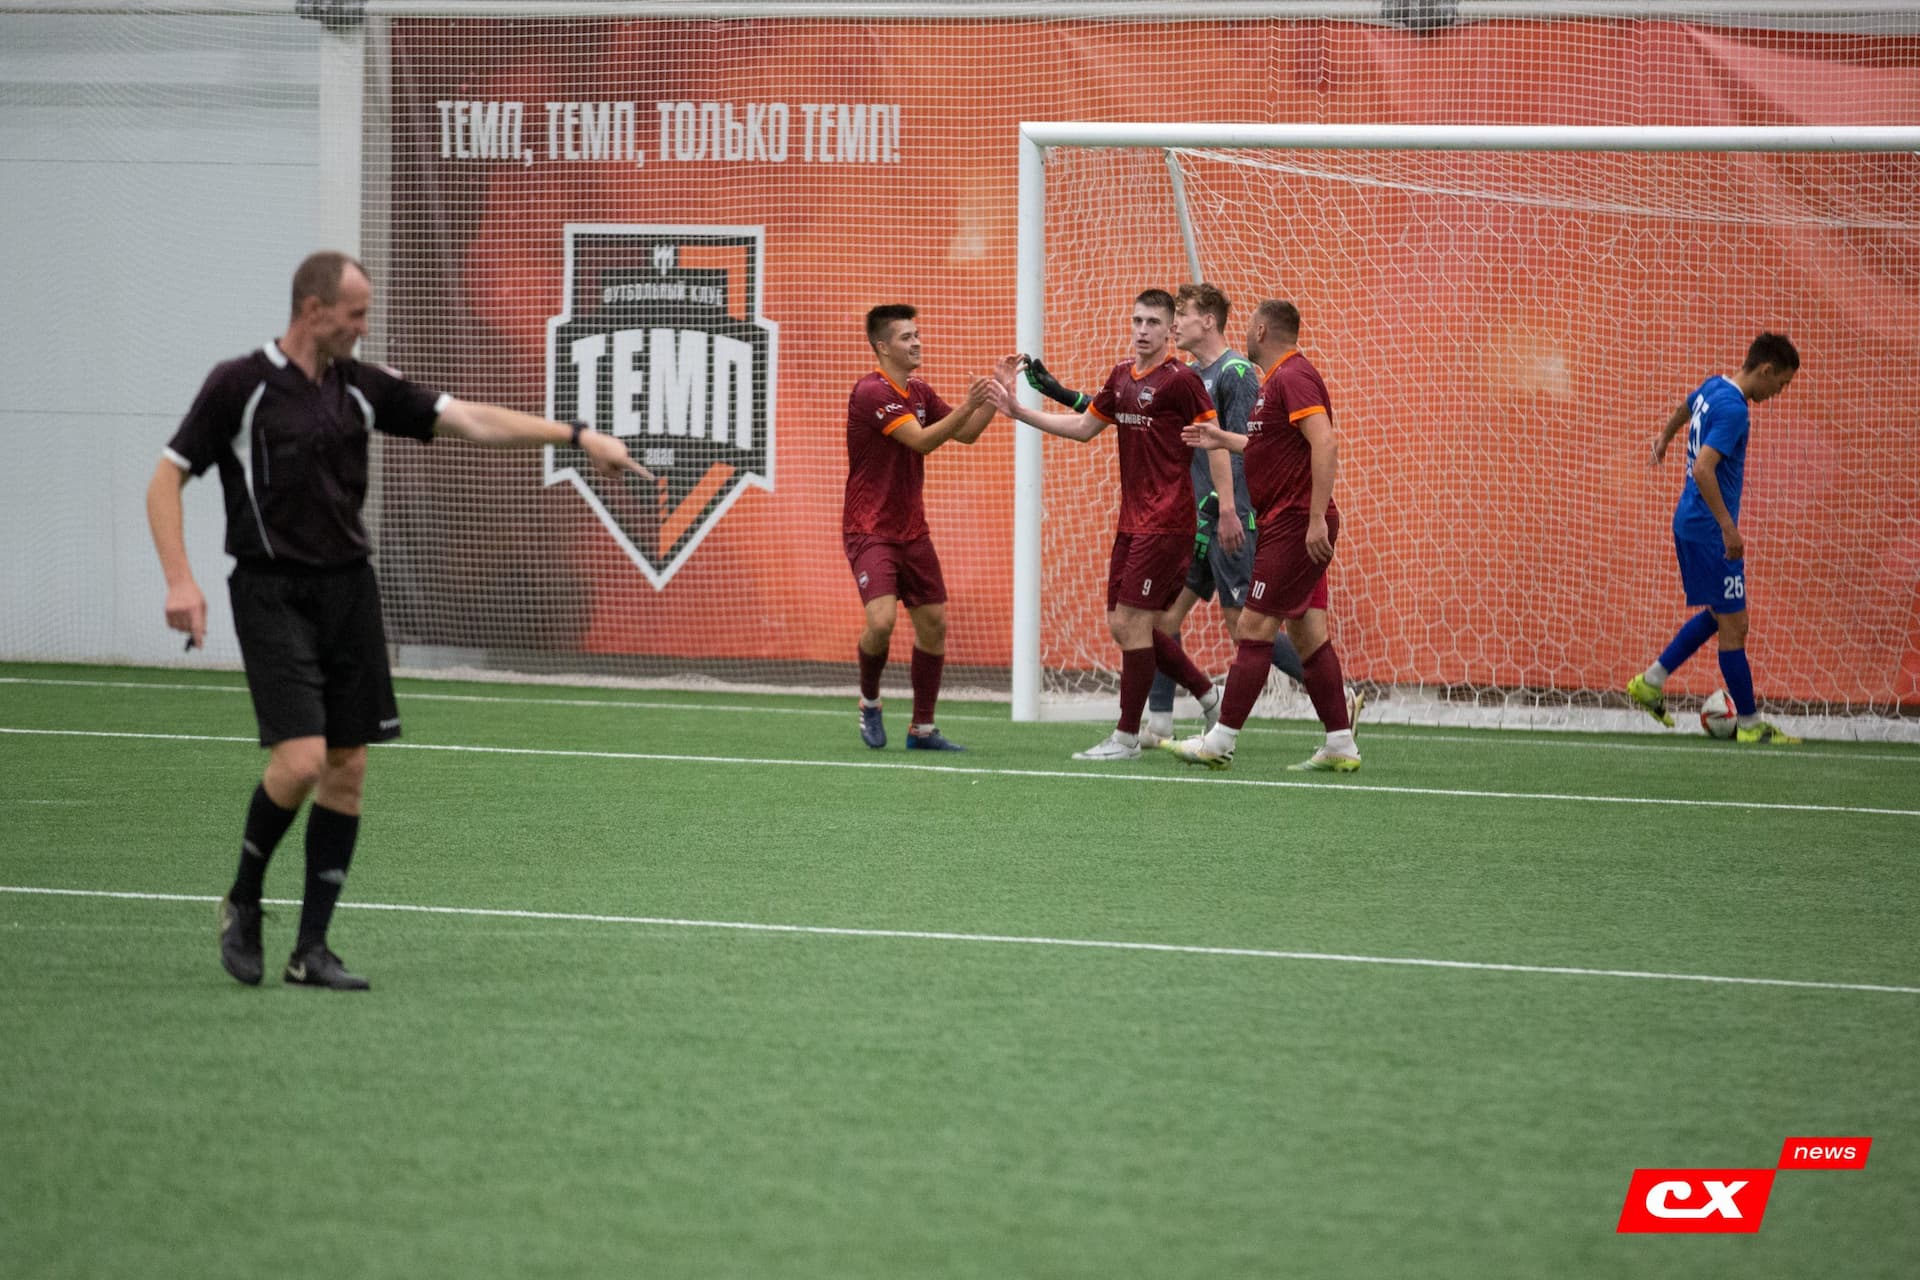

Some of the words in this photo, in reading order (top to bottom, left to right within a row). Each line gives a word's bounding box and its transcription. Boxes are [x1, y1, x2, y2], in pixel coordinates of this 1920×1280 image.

[437, 99, 533, 167] ТЕМП,
[545, 100, 645, 168] ТЕМП,
[657, 101, 789, 162] ТОЛЬКО
[800, 102, 900, 164] ТЕМП!
[603, 281, 686, 303] ФУТБОЛЬНЫЙ
[692, 285, 724, 306] КЛУБ
[571, 327, 753, 451] ТЕМП
[1141, 578, 1152, 596] 9
[1251, 580, 1266, 600] 10
[1723, 575, 1744, 599] 25
